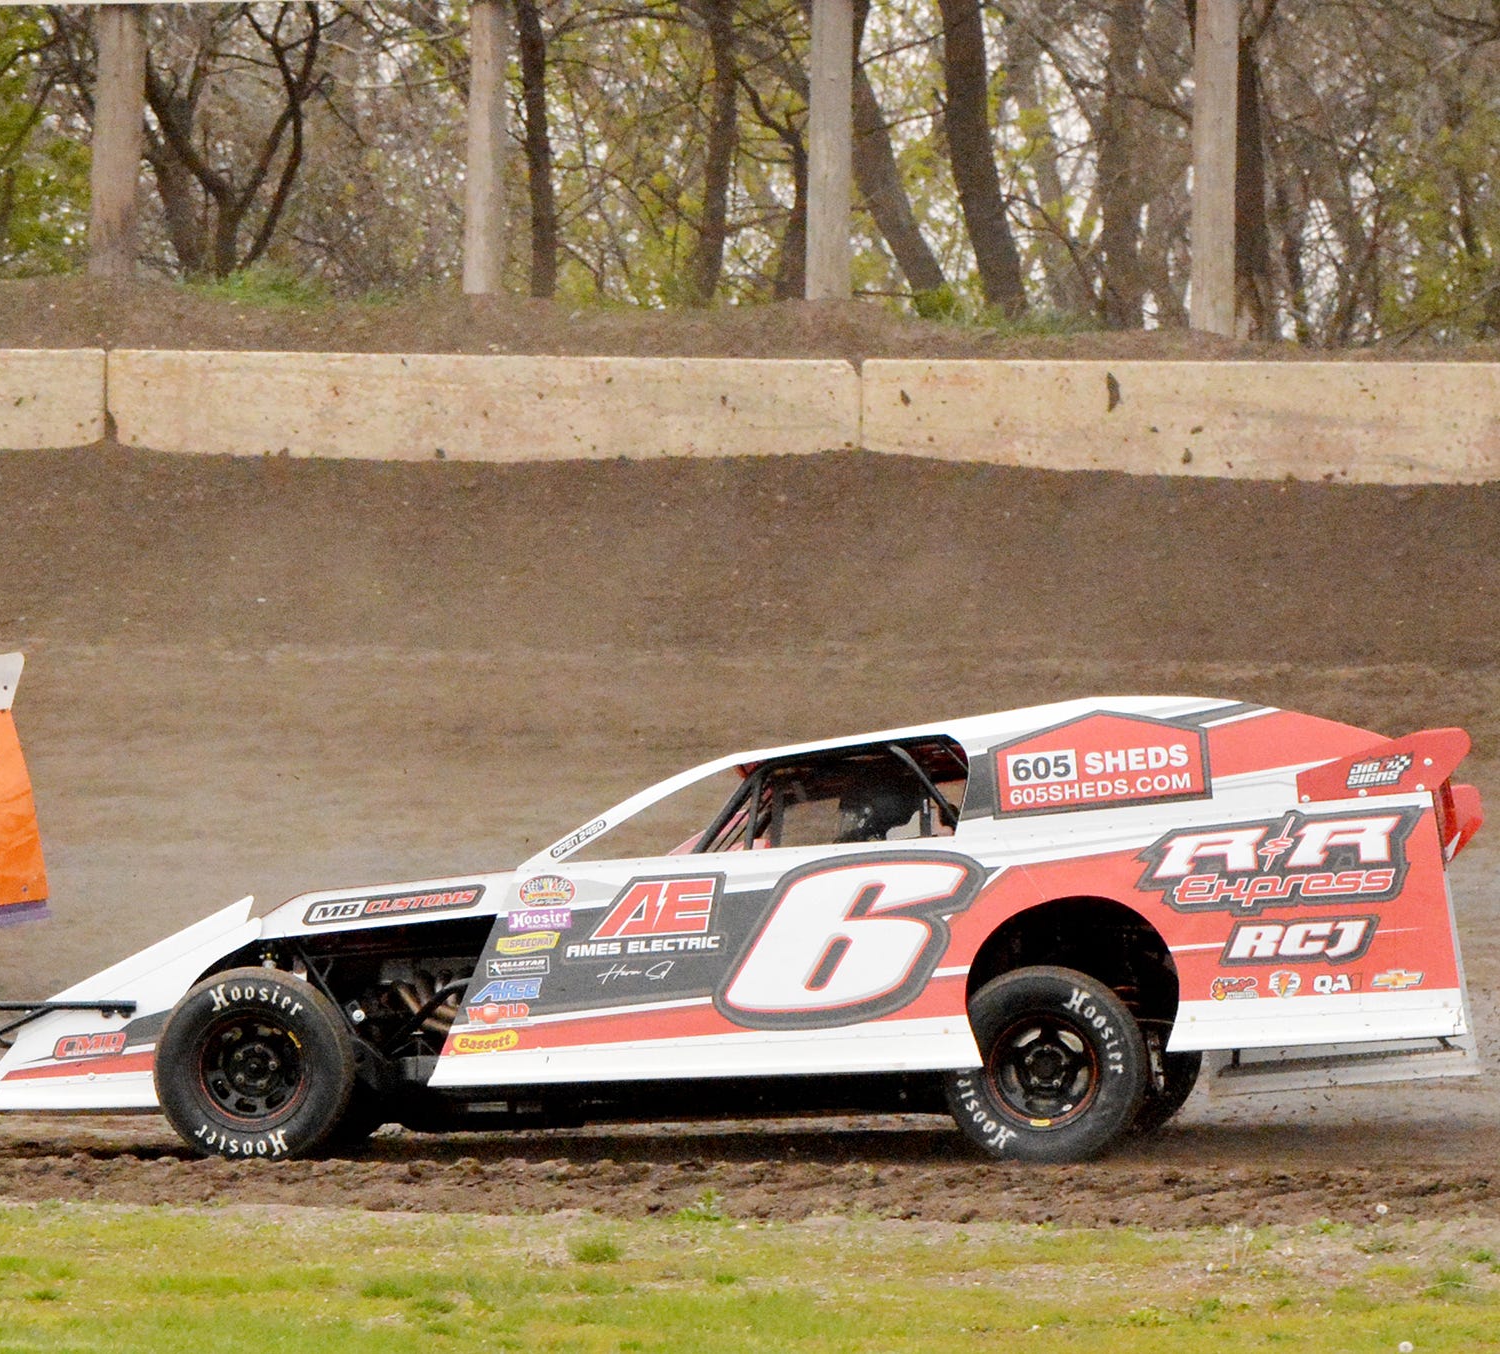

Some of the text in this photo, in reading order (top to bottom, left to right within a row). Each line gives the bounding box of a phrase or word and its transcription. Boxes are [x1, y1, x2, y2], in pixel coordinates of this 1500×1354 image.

[1011, 743, 1190, 782] 605 SHEDS
[1009, 772, 1192, 806] 605SHEDS.COM
[1173, 868, 1396, 907] Express
[315, 889, 478, 920] MB CUSTOMS
[509, 910, 571, 929] Hoosier
[589, 877, 717, 941] AE
[565, 935, 721, 958] AMES ELECTRIC
[723, 860, 971, 1014] 6
[1226, 919, 1370, 959] RCJ
[500, 959, 546, 968] ALLSTAR
[208, 983, 304, 1016] Hoosier
[470, 977, 543, 1003] AFCO
[1312, 972, 1364, 995] QA1
[466, 1002, 530, 1025] WORLD
[459, 1034, 512, 1050] Bassett
[1062, 987, 1124, 1075] Hoosier
[194, 1124, 289, 1157] Hoosier
